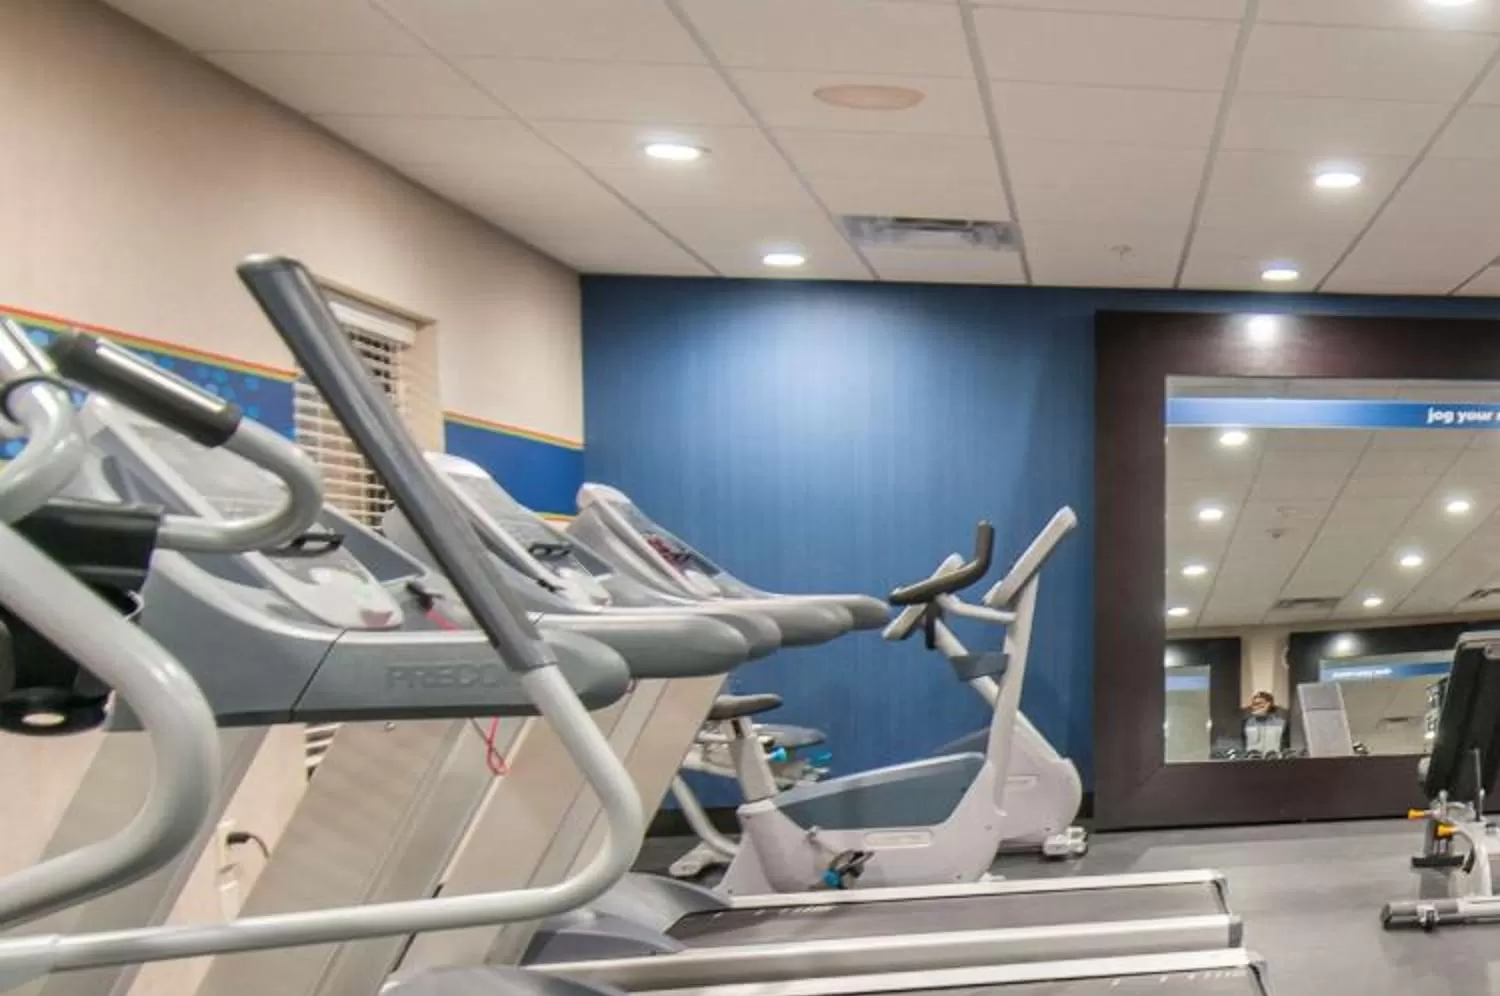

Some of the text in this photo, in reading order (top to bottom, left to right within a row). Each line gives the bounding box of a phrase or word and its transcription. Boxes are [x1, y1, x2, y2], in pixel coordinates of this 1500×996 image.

[1427, 407, 1454, 424] jog
[1457, 411, 1493, 424] your
[385, 663, 509, 689] PRECO
